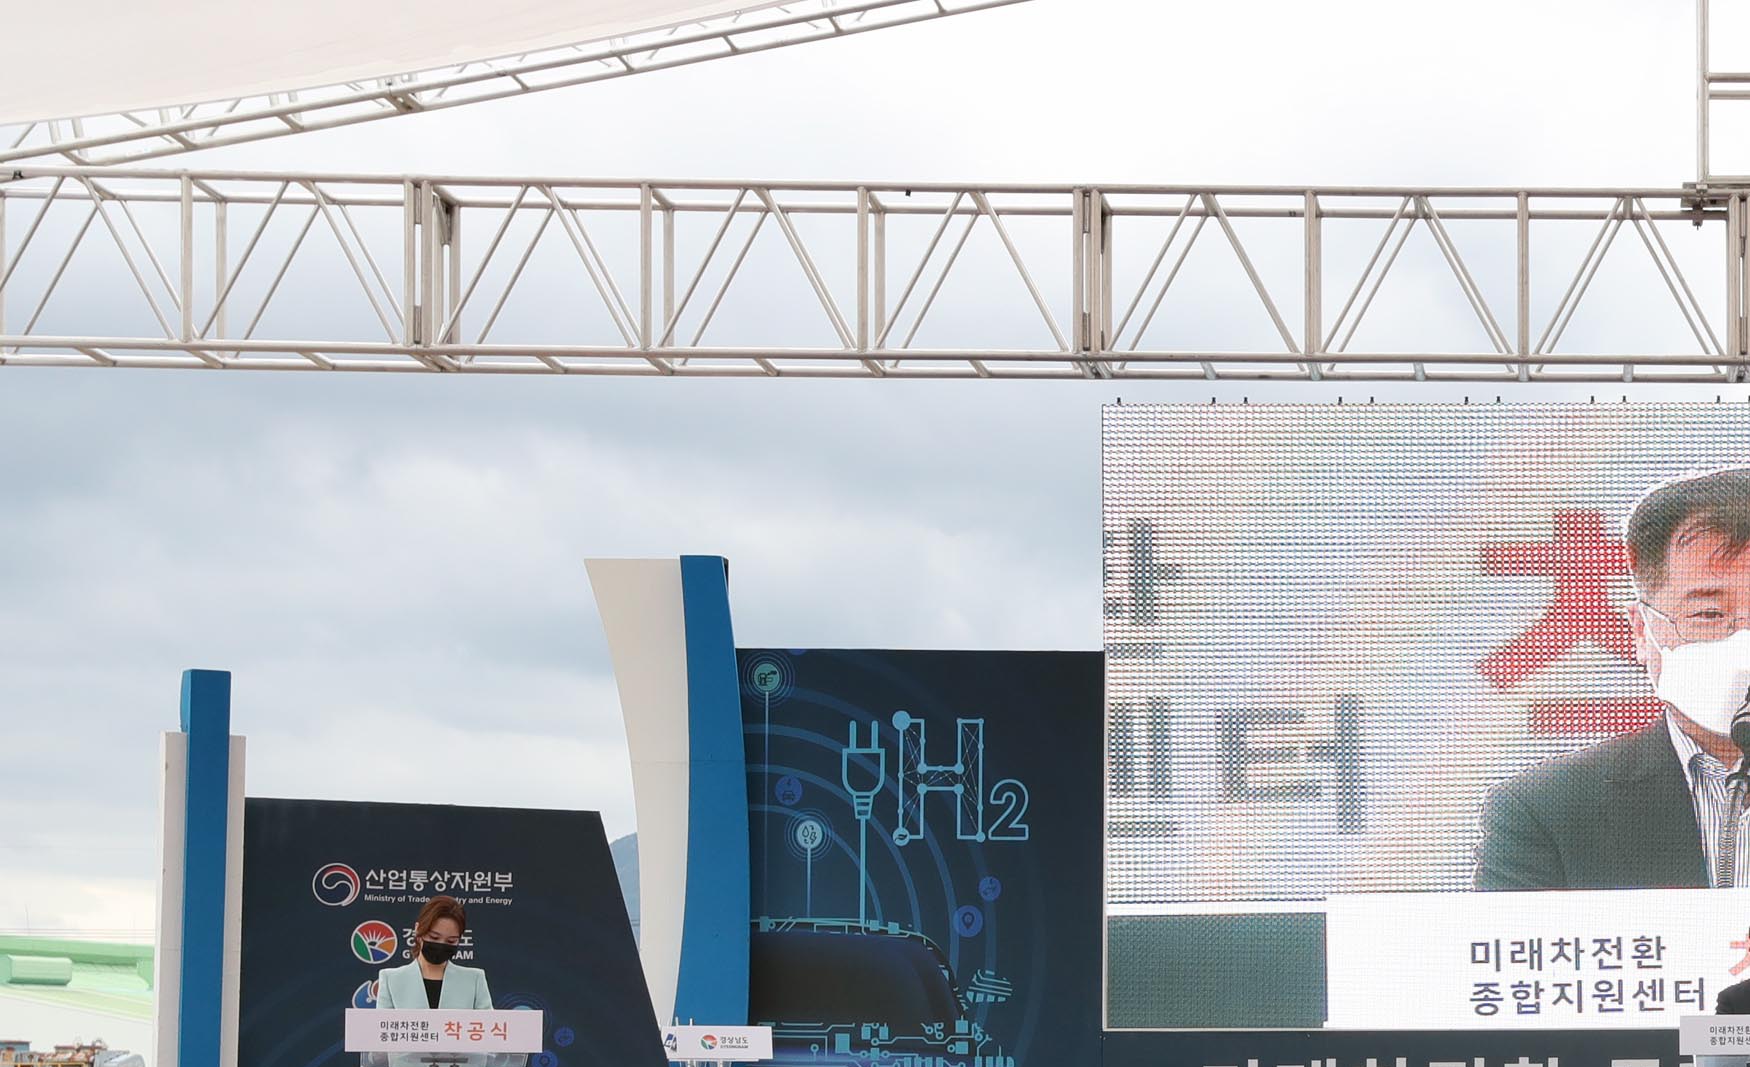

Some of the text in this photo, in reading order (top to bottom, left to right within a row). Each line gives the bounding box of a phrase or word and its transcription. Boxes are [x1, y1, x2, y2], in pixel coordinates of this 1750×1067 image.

[365, 869, 514, 892] 산업통상자원부
[364, 894, 396, 904] Ministry
[398, 895, 406, 903] of
[468, 897, 484, 905] and
[485, 897, 513, 906] Energy
[1470, 935, 1667, 972] 미래차전환
[1470, 977, 1705, 1016] 종합지원센터
[380, 1021, 429, 1031] 미래차전환
[444, 1021, 508, 1041] 착공식
[380, 1032, 439, 1043] 종합지원센터
